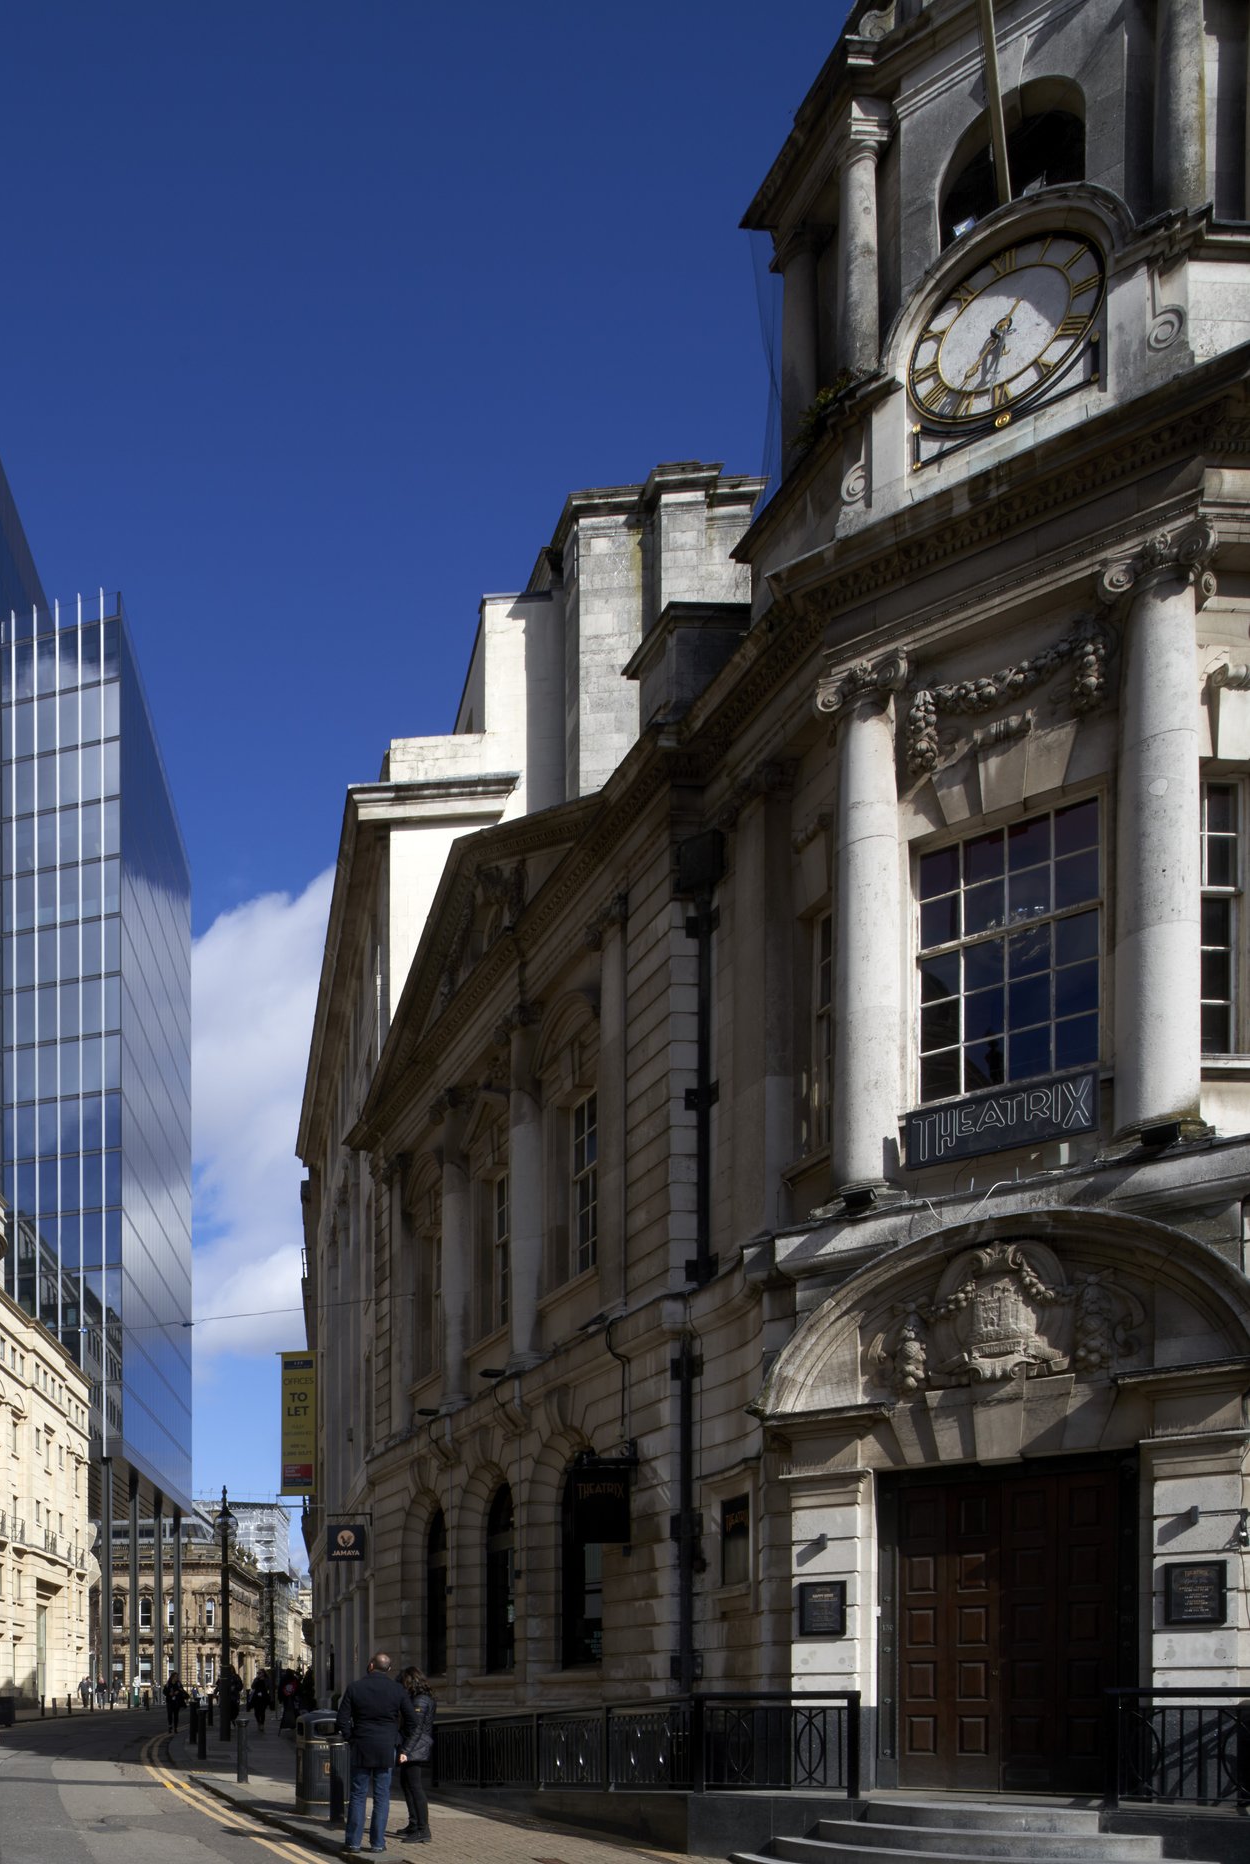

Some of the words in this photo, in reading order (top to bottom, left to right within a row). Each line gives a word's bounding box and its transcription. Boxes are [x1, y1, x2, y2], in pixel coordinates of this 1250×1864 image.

[912, 1078, 1092, 1161] THEATRIX
[290, 1392, 308, 1403] TO
[287, 1406, 309, 1416] LET
[576, 1483, 625, 1500] THEATRIX
